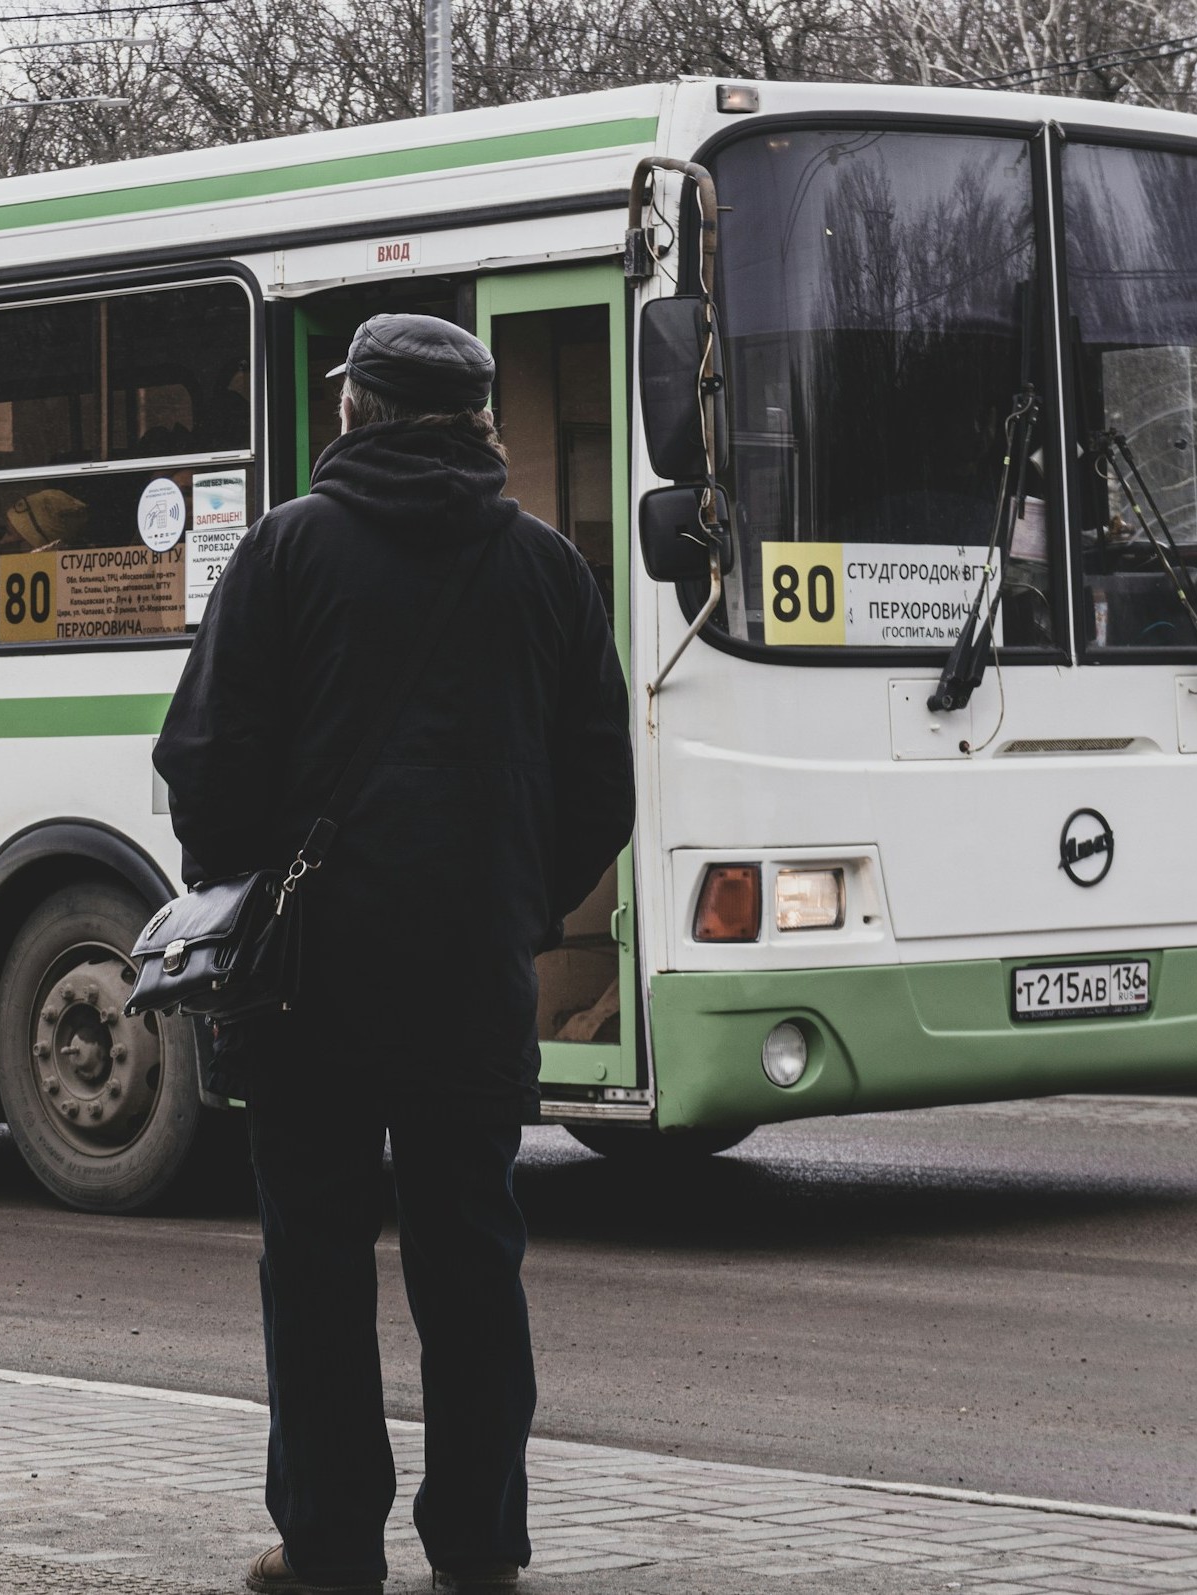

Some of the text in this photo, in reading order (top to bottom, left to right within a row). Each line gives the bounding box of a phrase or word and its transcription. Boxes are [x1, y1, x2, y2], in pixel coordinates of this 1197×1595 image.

[377, 242, 411, 263] ВХОД
[196, 511, 242, 526] ЗАПРЕЩЕН!
[192, 533, 241, 543] СТОИМОСТЬ
[198, 542, 234, 552] ПРОЕЗДА
[61, 548, 183, 572] СТУДГОРОДОК ВГТУ
[207, 565, 223, 581] 23
[847, 563, 959, 584] СТУДГОРОДОК
[6, 571, 51, 625] 80
[772, 564, 835, 623] 80
[57, 620, 143, 638] ПЕРХОРОВИЧА
[882, 626, 961, 639] (ГОСПИТАЛЬ МВ
[1113, 966, 1141, 991] 136
[1119, 992, 1134, 1000] RUS
